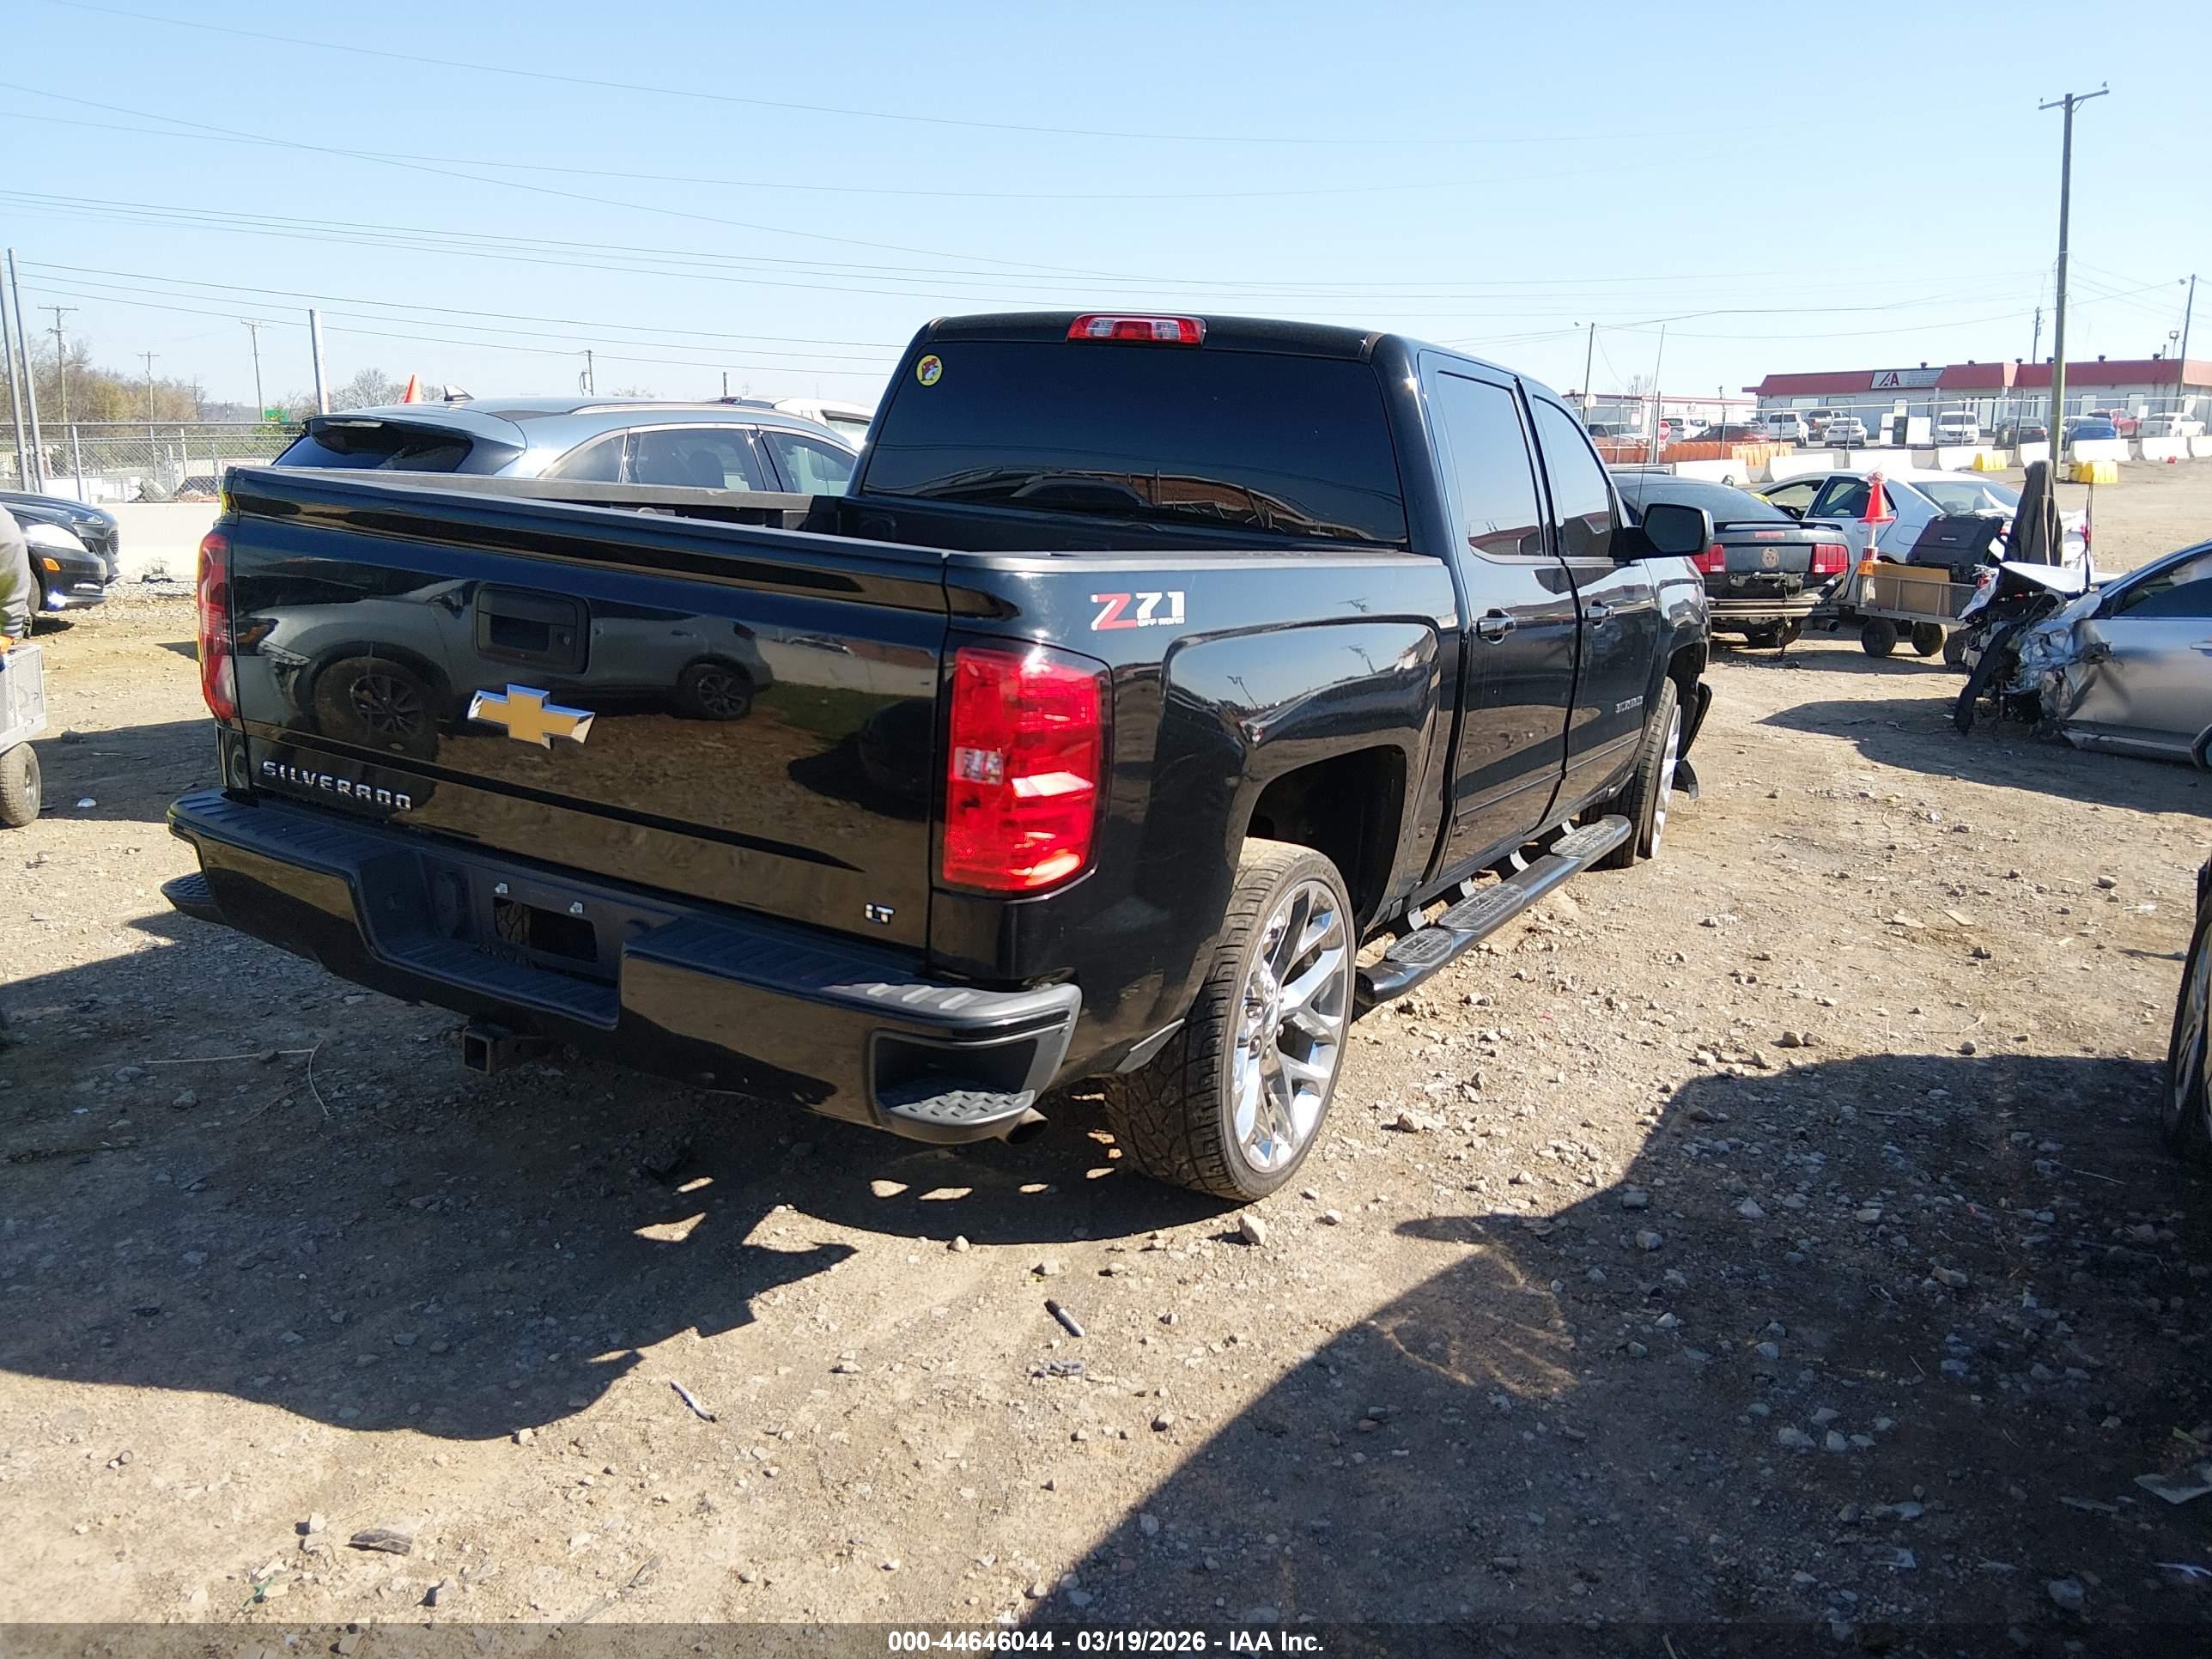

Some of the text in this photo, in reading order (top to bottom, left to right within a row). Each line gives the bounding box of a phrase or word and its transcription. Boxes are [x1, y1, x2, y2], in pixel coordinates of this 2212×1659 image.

[1091, 591, 1185, 631] Z71
[263, 761, 411, 811] SILVERADO
[865, 903, 894, 923] LT
